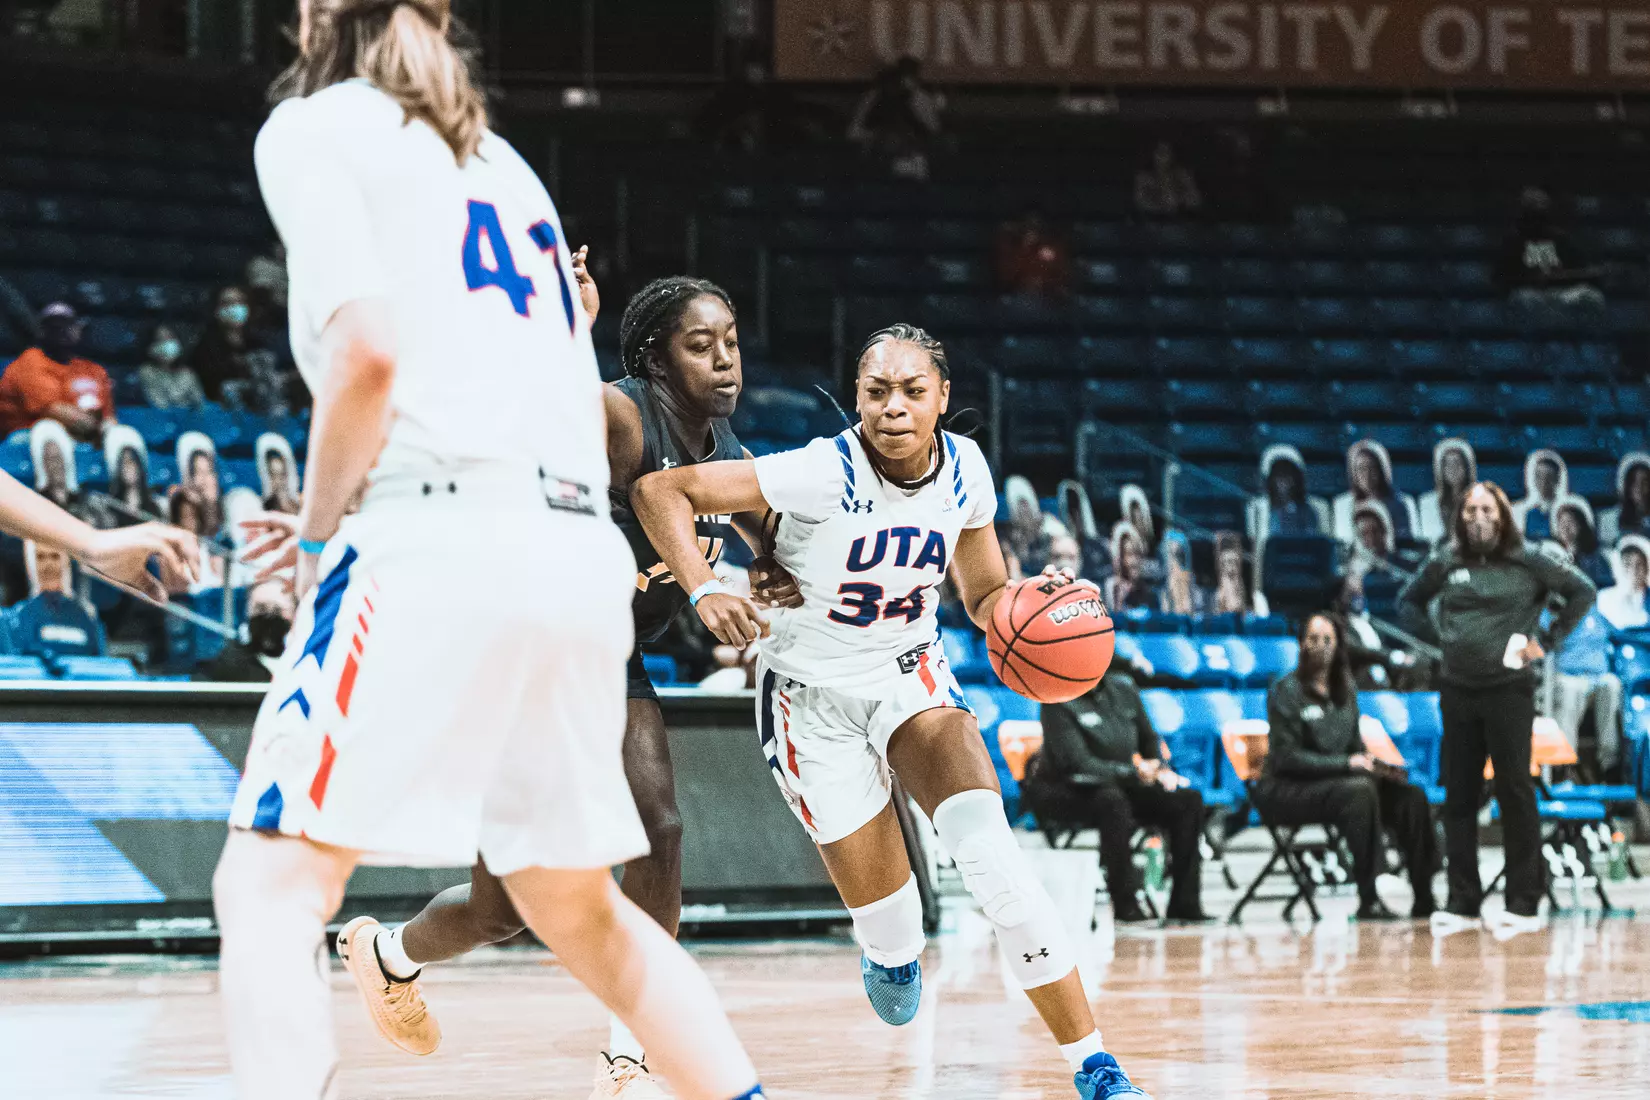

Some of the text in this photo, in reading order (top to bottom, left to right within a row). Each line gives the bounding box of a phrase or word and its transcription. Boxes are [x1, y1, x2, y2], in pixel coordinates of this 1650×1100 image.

[870, 1, 1391, 72] UNIVERSITY
[1420, 5, 1532, 75] OF
[845, 526, 947, 575] UTA
[827, 581, 934, 629] 34
